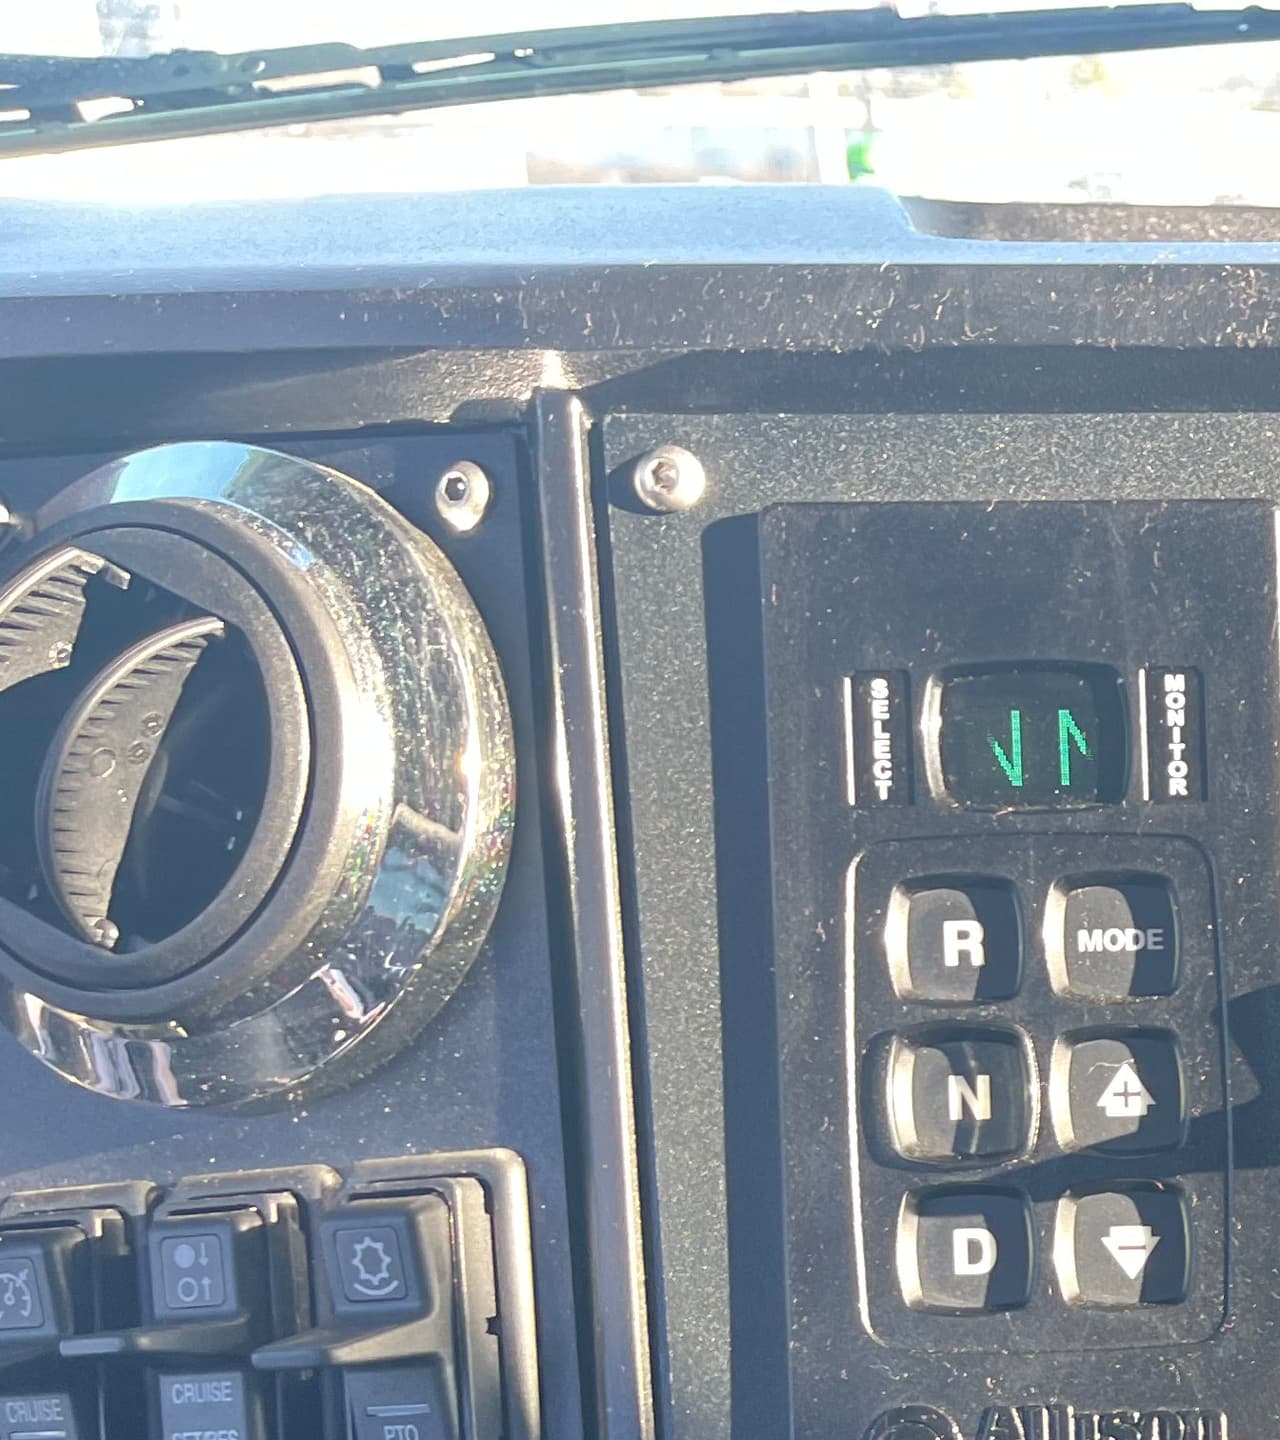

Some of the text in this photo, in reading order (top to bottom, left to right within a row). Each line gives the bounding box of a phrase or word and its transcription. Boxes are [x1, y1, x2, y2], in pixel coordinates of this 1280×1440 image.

[870, 679, 891, 800] SELECT
[1164, 674, 1188, 795] MONITOR
[943, 920, 985, 967] R
[1078, 929, 1164, 952] MODE
[949, 1075, 991, 1121] N
[953, 1228, 997, 1275] D
[7, 1400, 64, 1423] CRUISE
[172, 1381, 232, 1404] CRUISE
